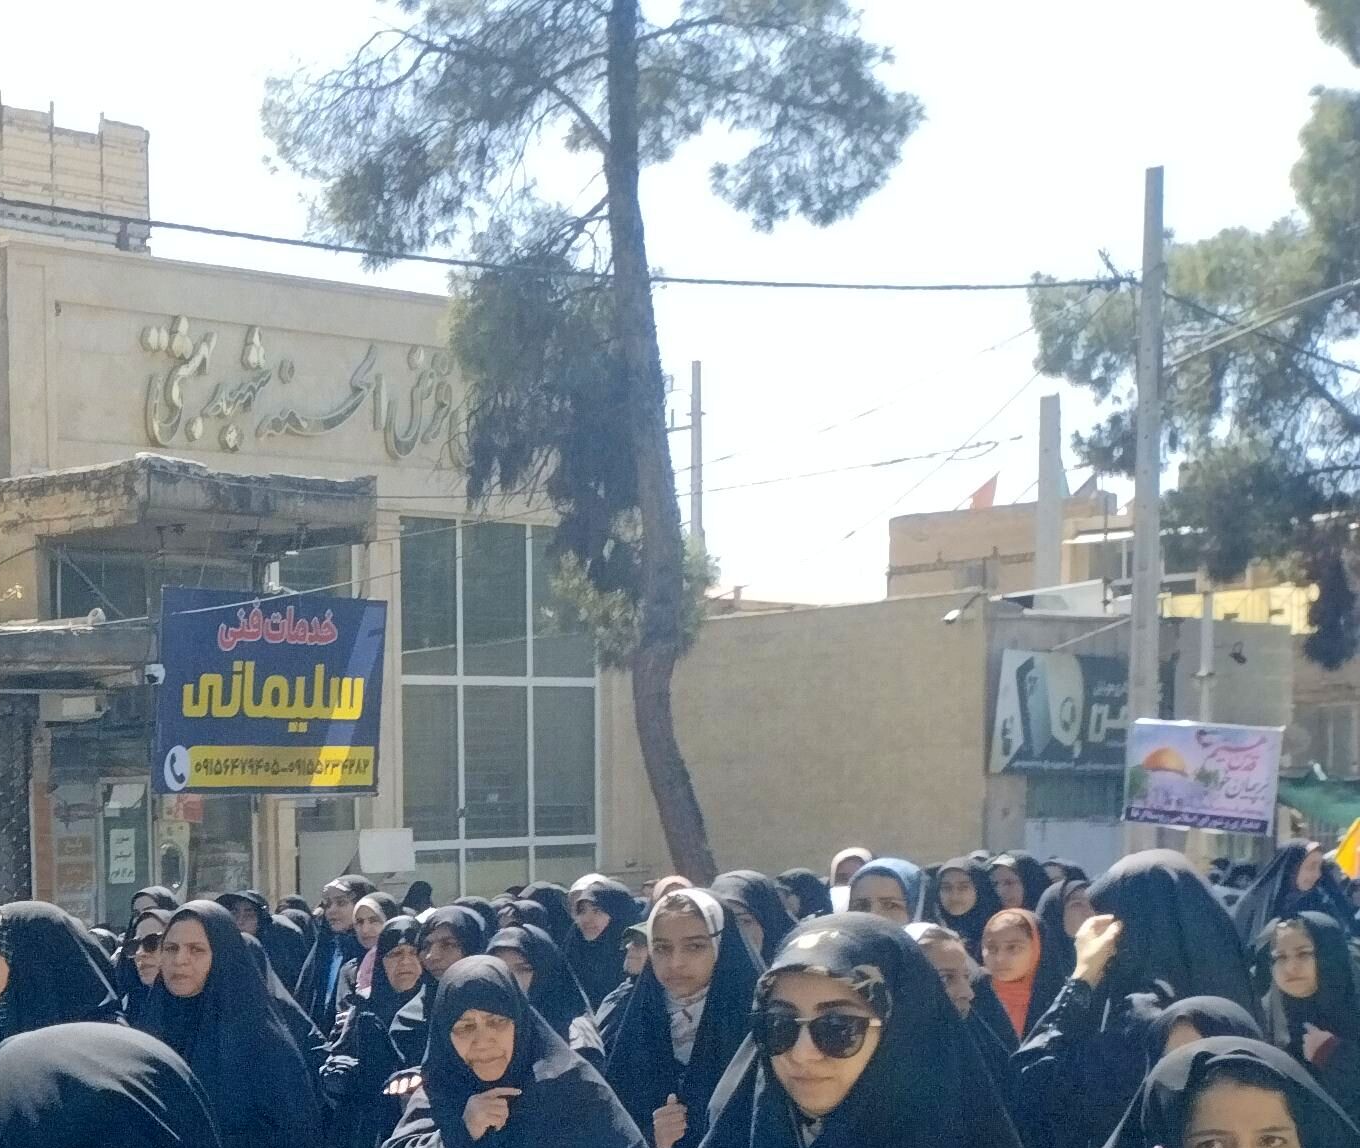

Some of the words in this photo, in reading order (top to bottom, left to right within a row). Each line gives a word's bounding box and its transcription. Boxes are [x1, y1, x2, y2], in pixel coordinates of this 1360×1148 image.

[218, 597, 263, 651] فنی
[262, 606, 338, 645] خدمات
[182, 660, 364, 733] سلیمانی
